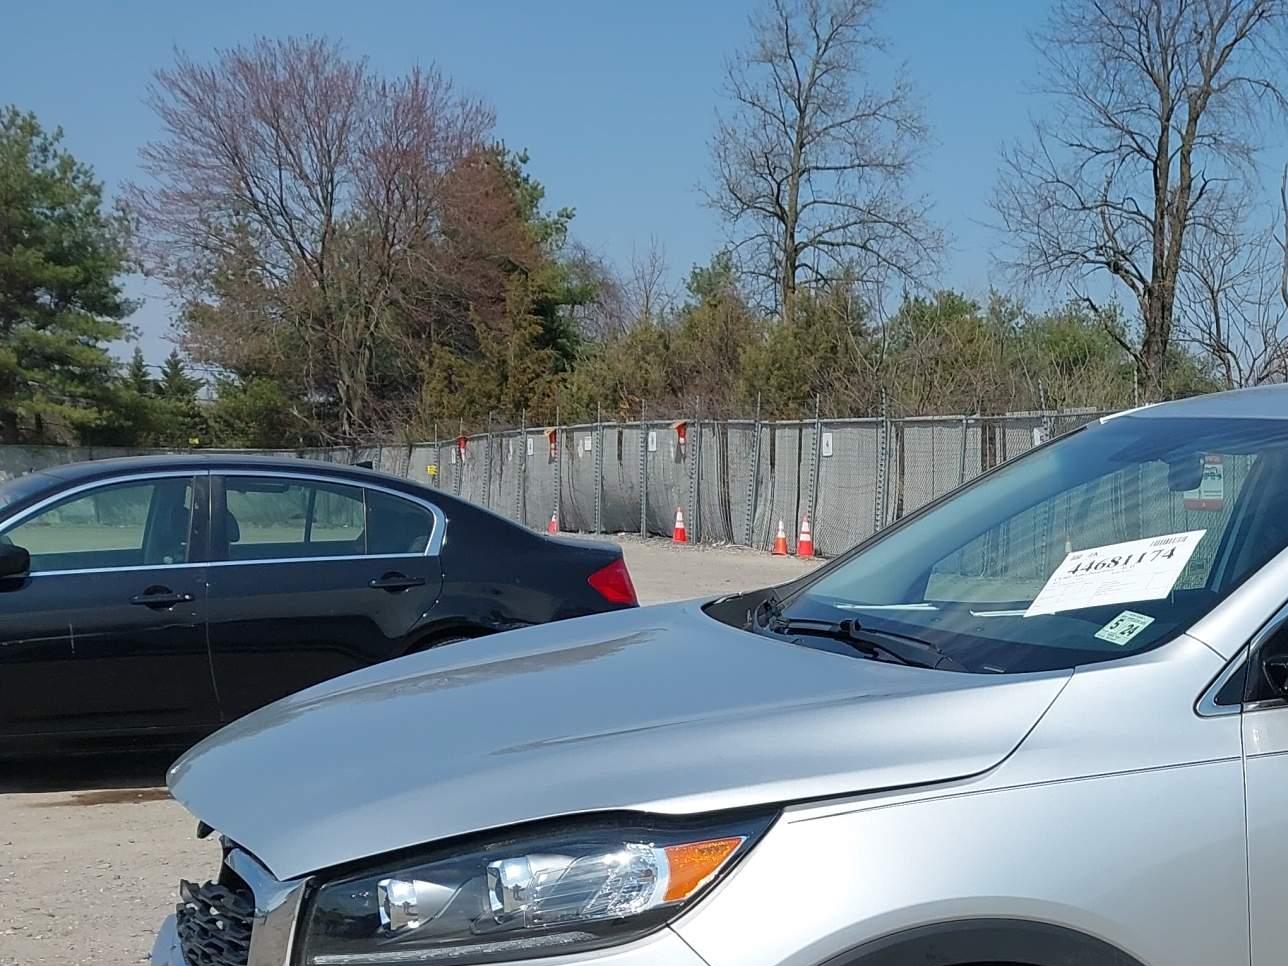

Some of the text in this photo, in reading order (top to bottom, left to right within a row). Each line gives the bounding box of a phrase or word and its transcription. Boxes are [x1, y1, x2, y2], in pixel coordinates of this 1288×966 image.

[1067, 546, 1177, 575] 44681174
[1109, 618, 1125, 630] 5
[1119, 624, 1140, 637] 24
